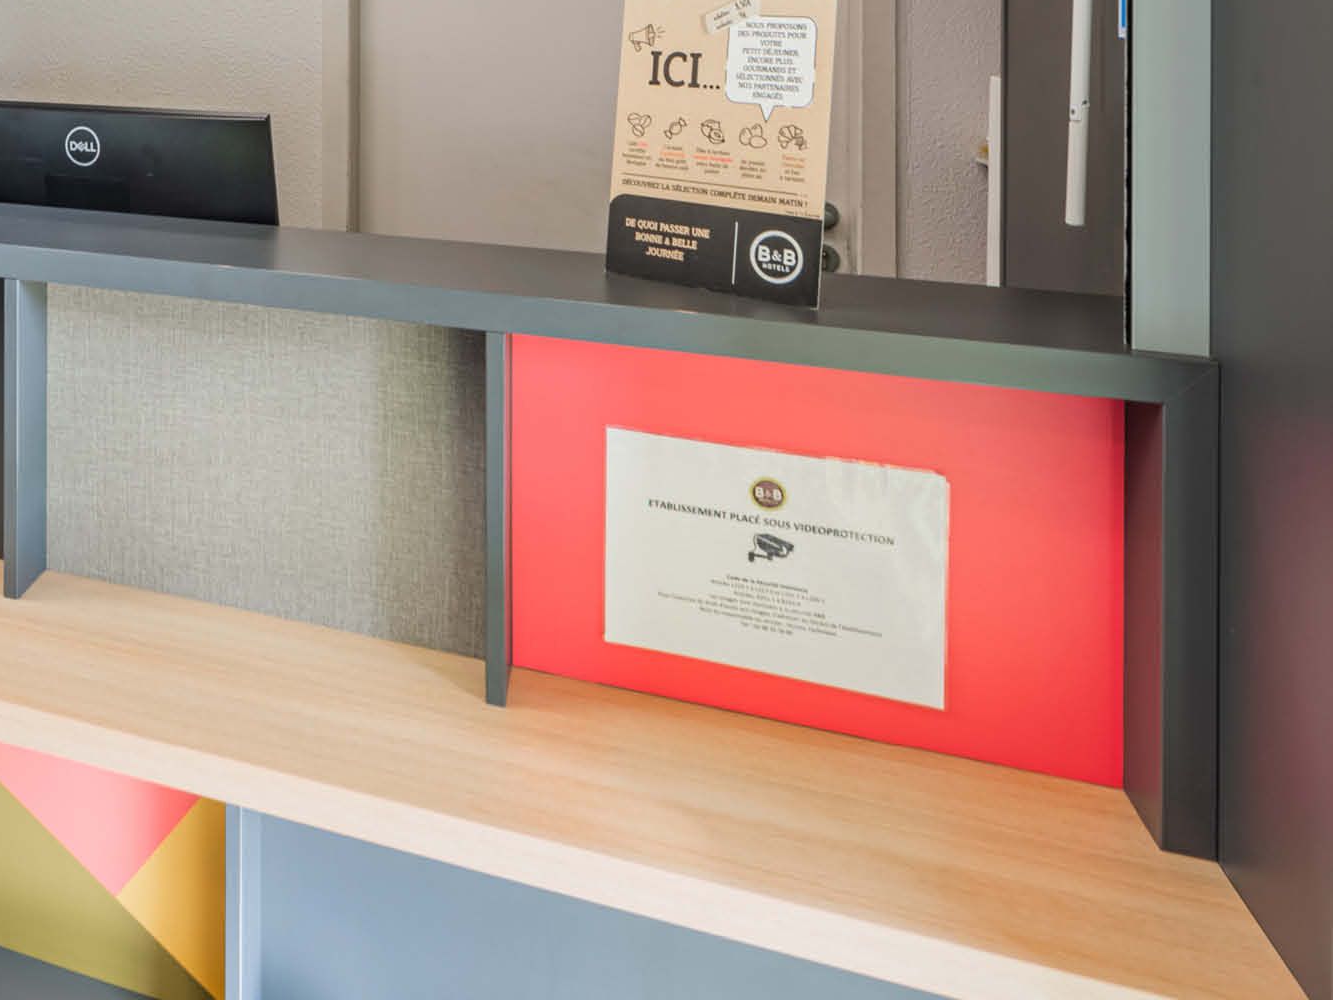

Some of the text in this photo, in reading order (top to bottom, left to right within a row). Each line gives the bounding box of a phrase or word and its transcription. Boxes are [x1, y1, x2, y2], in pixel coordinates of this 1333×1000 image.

[69, 141, 96, 152] DELL
[778, 197, 803, 208] MATIN
[626, 217, 710, 239] DE QUOI PASSER UNE
[635, 231, 663, 245] BONNE
[672, 237, 698, 251] BELLE
[758, 244, 796, 267] B&B
[761, 262, 790, 273] HOTELS
[648, 499, 895, 545] ETABLISSEMENT PLACÉ SOUS VIDEOPROTECTION
